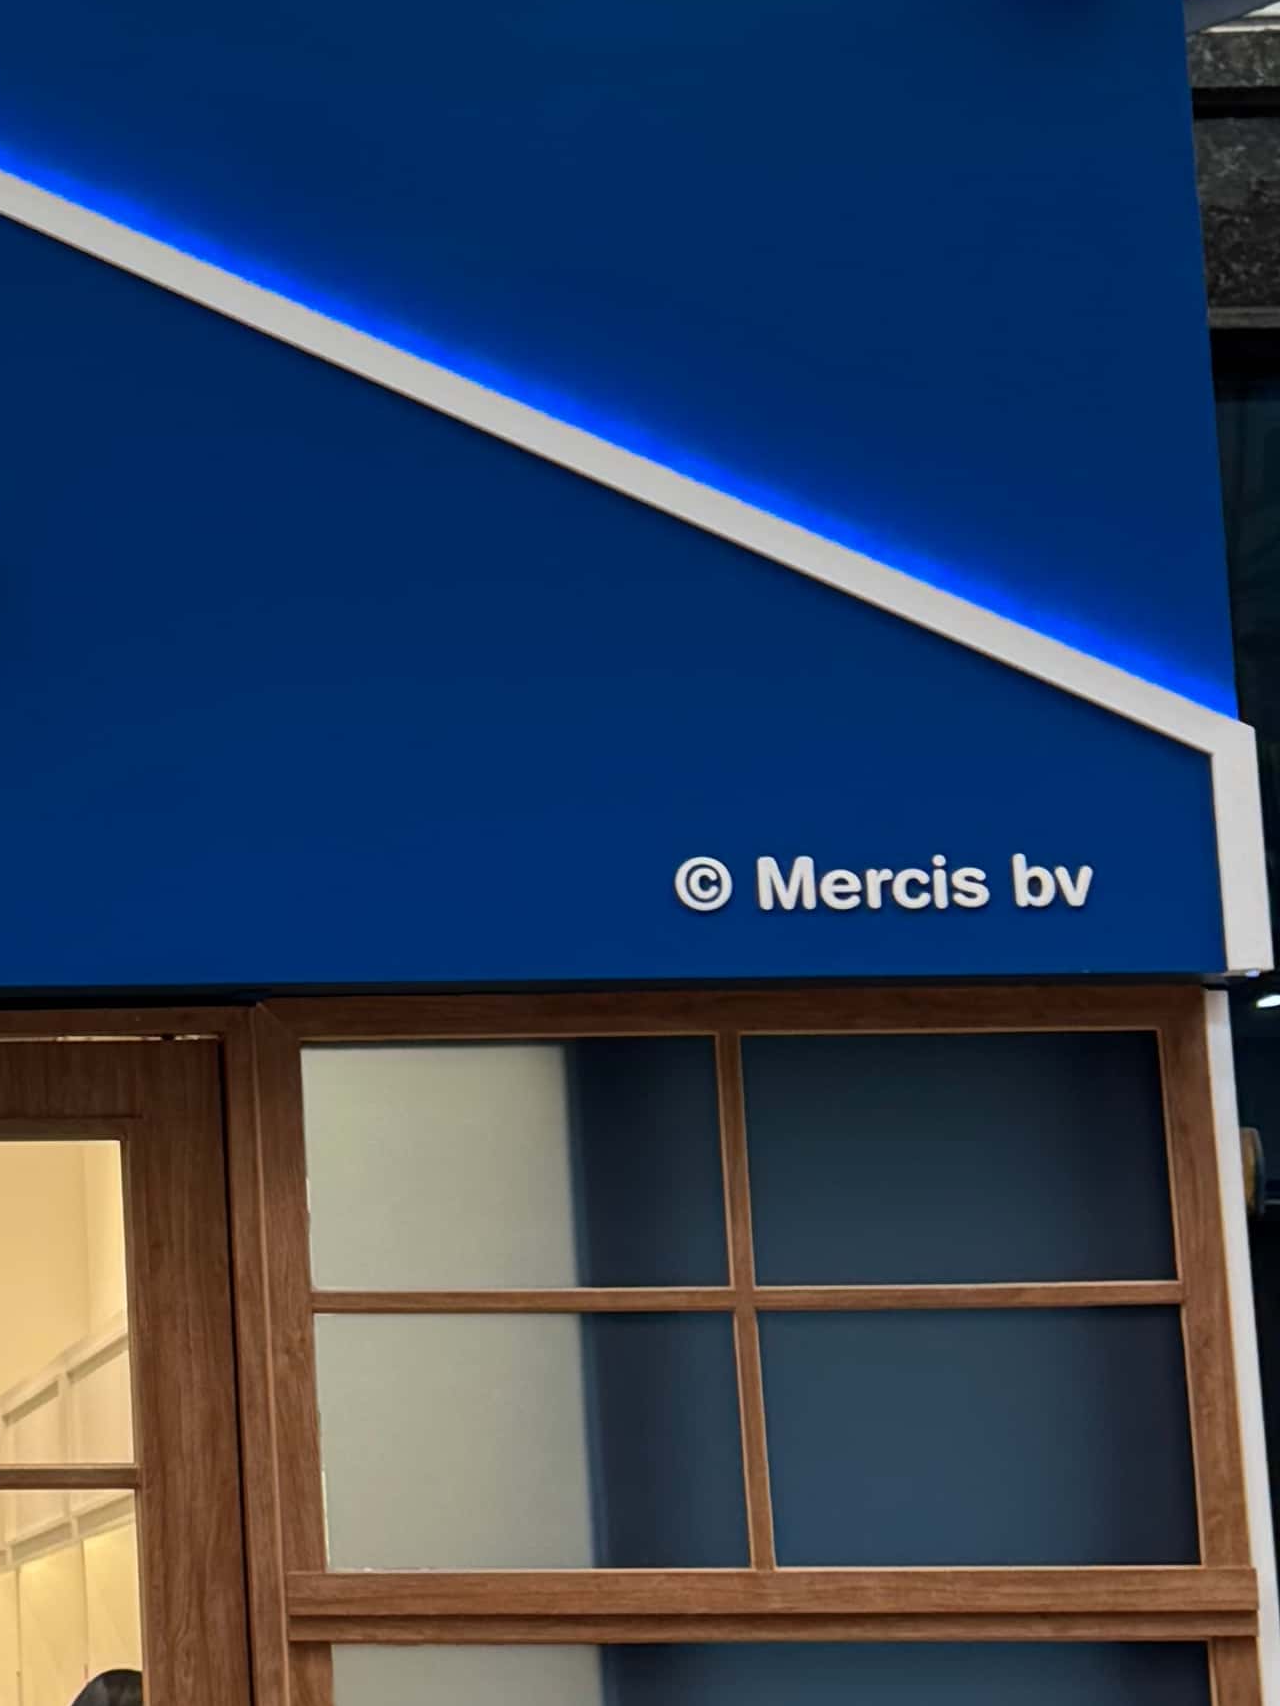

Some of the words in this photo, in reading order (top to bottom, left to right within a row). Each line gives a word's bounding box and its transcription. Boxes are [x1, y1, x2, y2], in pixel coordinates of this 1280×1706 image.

[674, 856, 733, 911] ©
[757, 854, 990, 911] Mercis
[1012, 853, 1093, 907] bv
